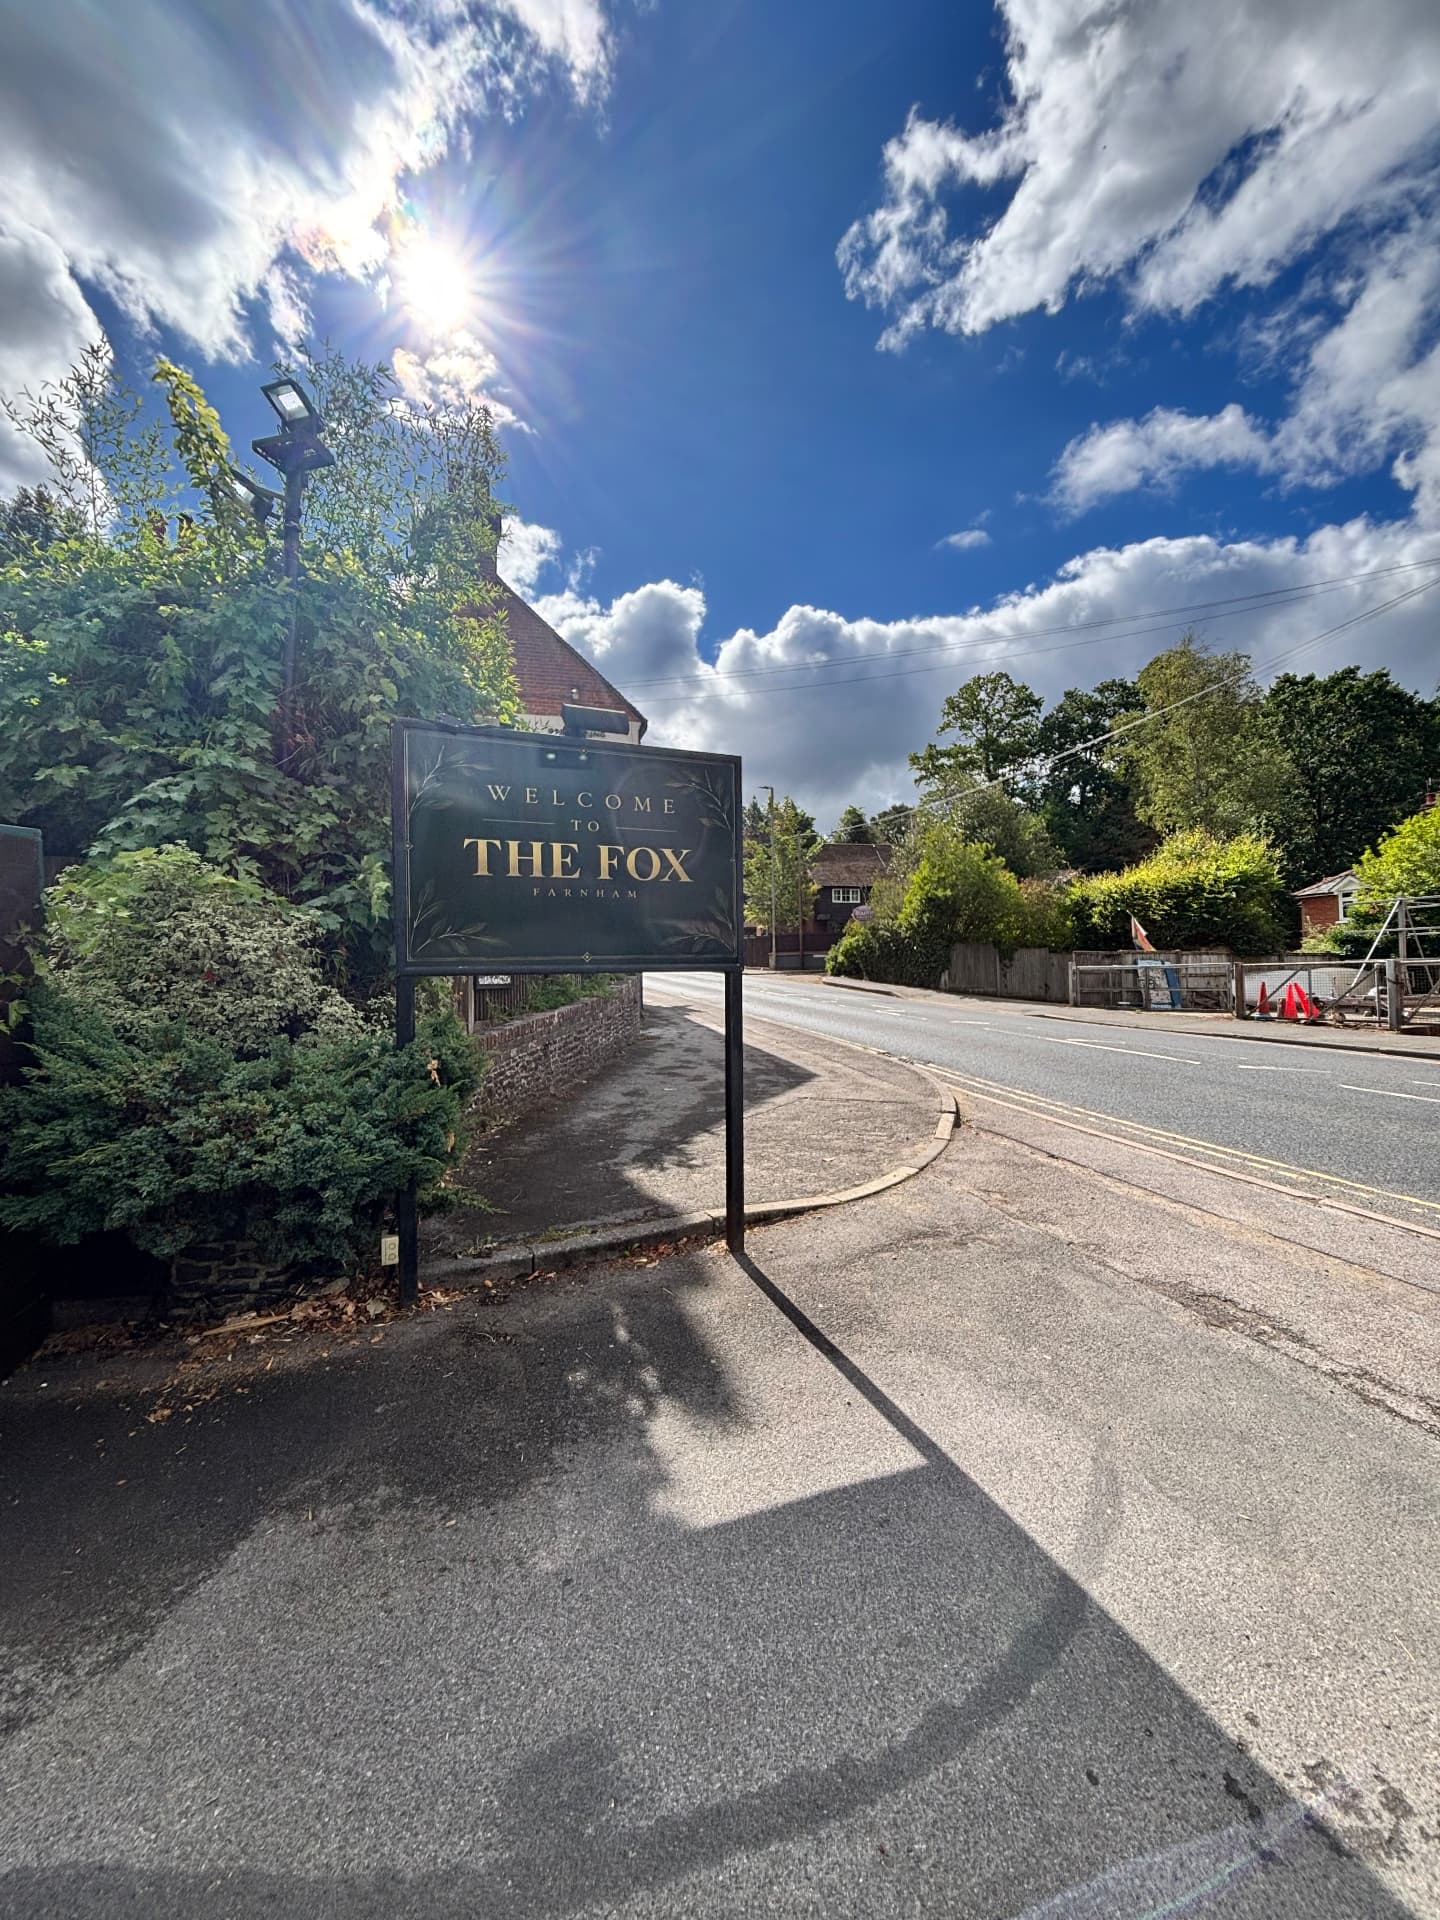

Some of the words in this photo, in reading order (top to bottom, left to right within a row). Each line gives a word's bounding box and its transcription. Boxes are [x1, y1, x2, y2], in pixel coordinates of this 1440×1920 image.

[487, 784, 676, 814] WELCOME
[571, 819, 600, 833] TO
[463, 838, 581, 880] THE
[597, 844, 694, 883] FOX
[533, 887, 638, 899] FARNHAM
